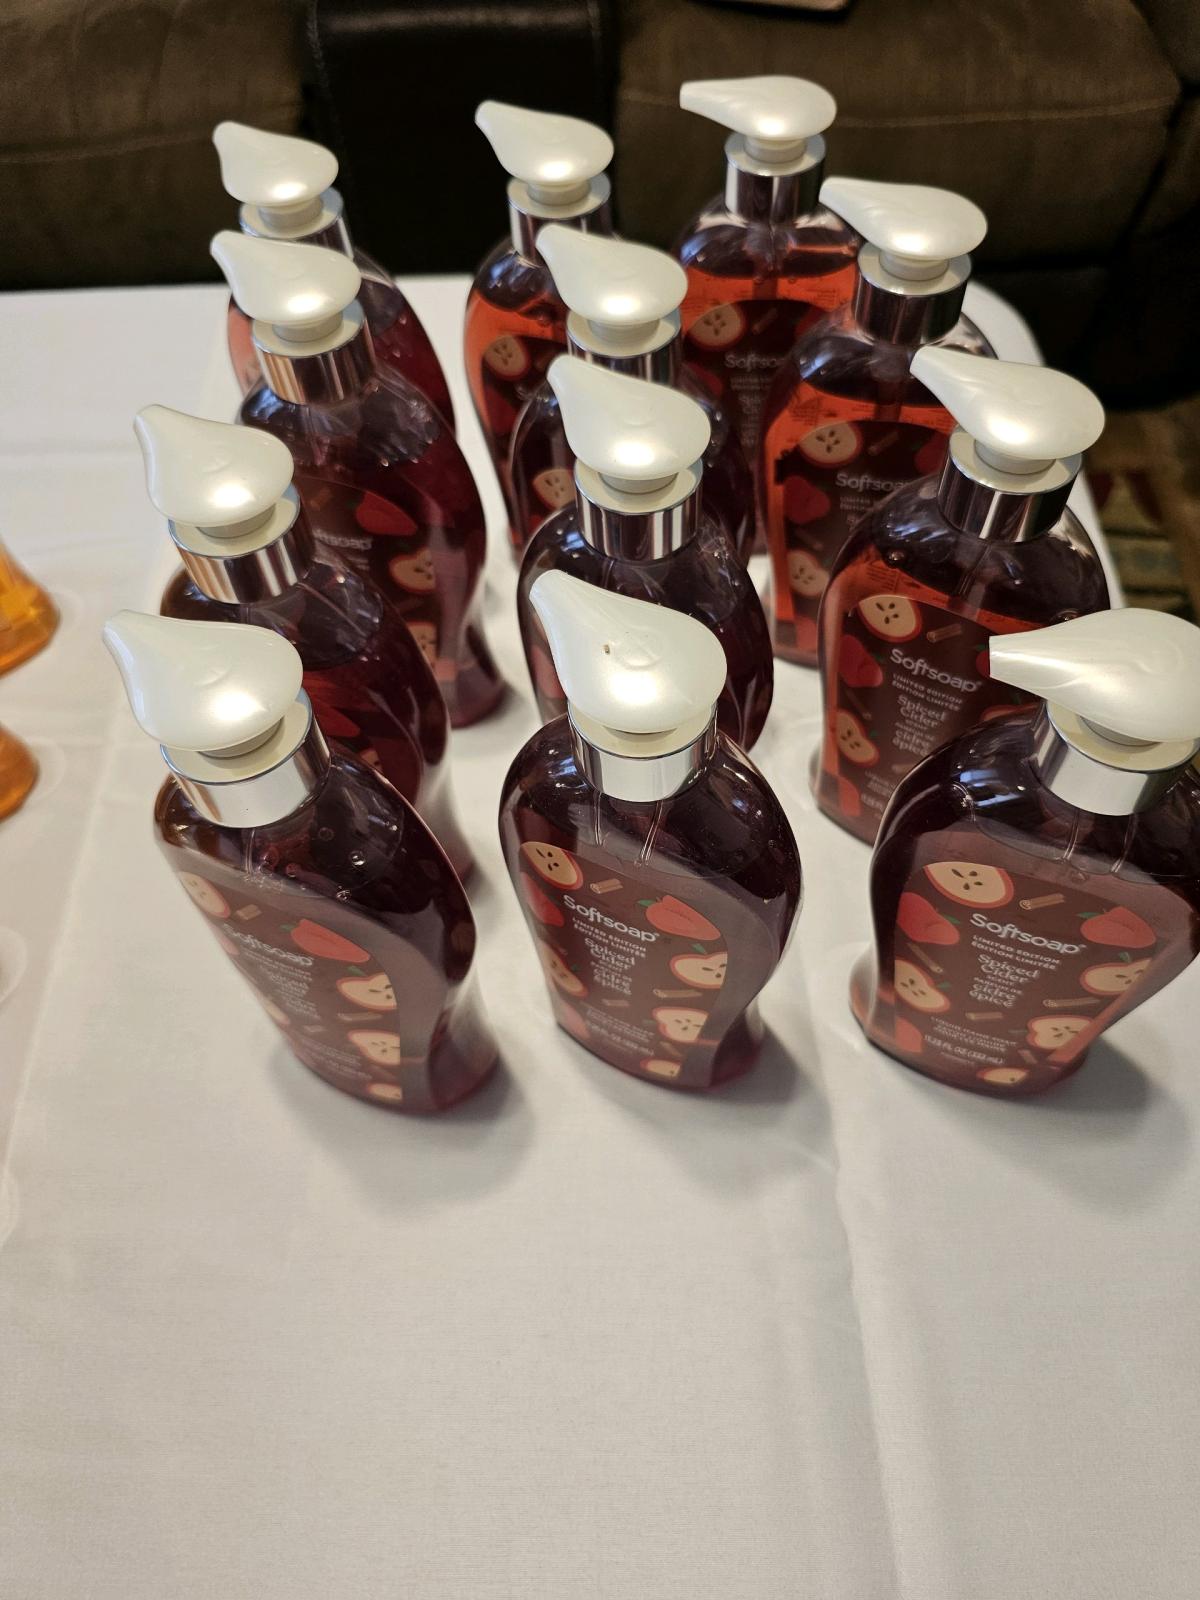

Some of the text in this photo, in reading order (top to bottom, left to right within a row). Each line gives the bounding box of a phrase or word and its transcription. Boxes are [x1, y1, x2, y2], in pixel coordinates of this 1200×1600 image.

[890, 648, 978, 692] Softsoap
[893, 673, 963, 704] LIMITED EDITION
[897, 695, 945, 721] Spiced
[900, 706, 938, 727] Cider
[563, 894, 656, 942] Softsoap
[573, 917, 647, 952] LIMITED EDITION
[970, 913, 1080, 954] Softsoap
[585, 938, 635, 965] Spiced
[590, 948, 631, 969] Cider
[973, 935, 1060, 964] LIMITED EDITION
[978, 954, 1040, 978] Spiced
[981, 964, 1029, 983] Cider
